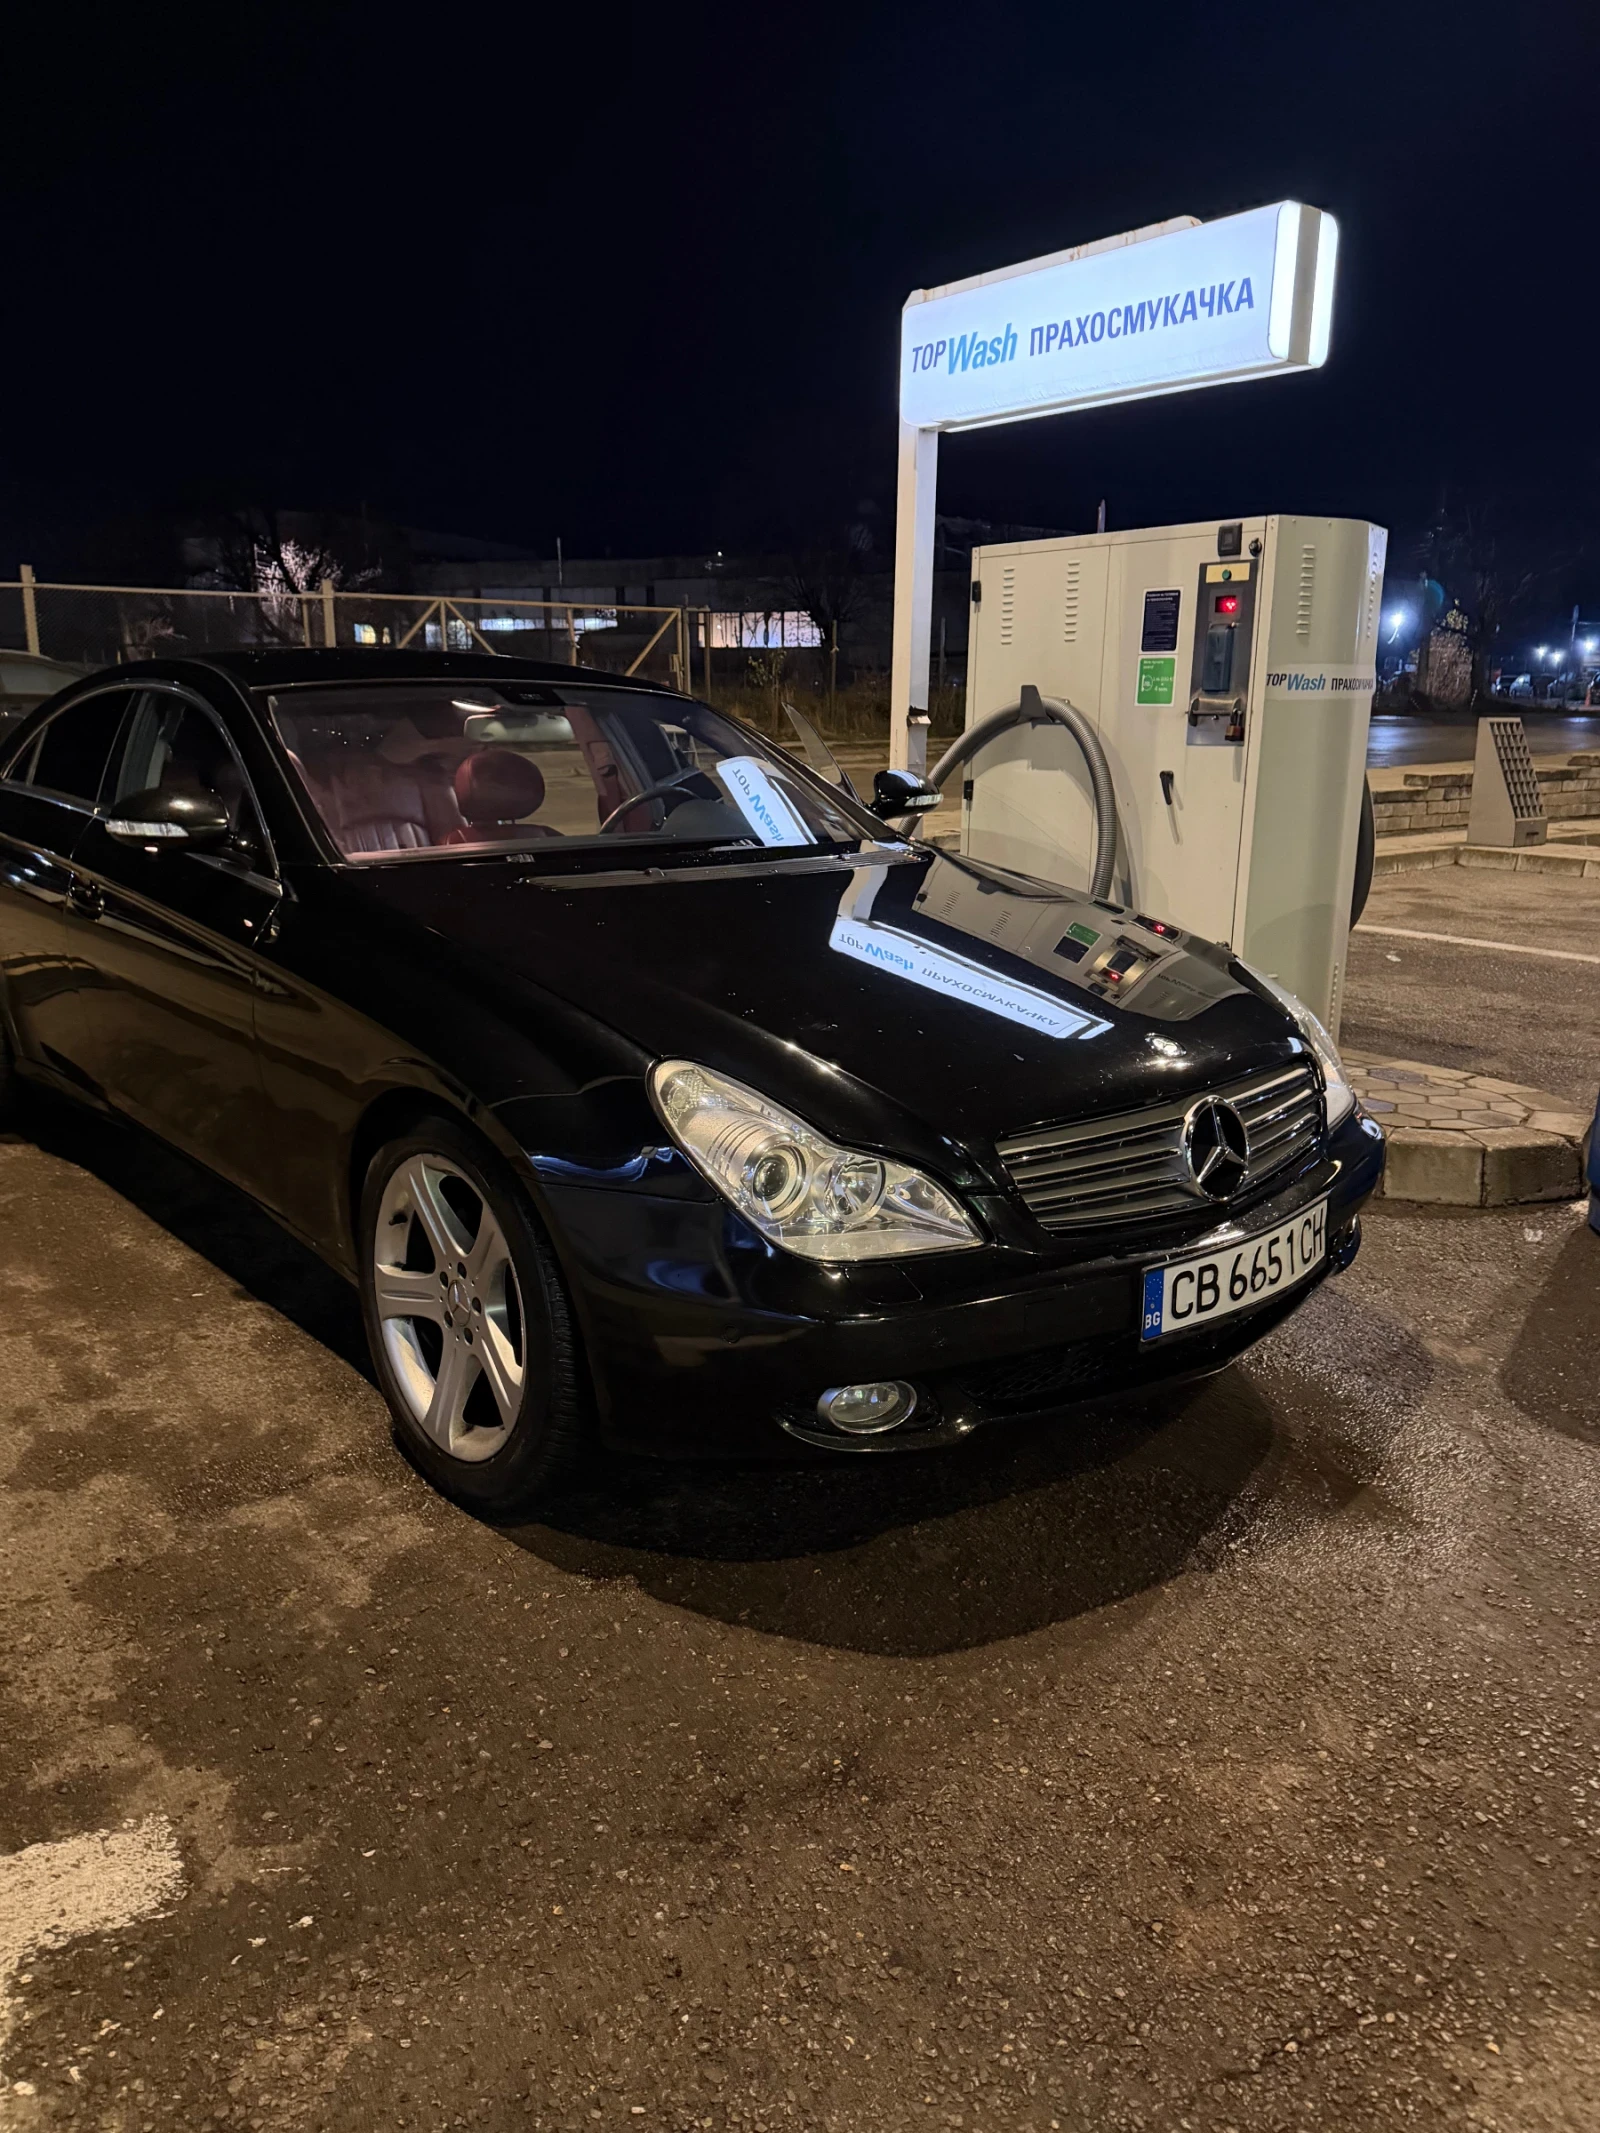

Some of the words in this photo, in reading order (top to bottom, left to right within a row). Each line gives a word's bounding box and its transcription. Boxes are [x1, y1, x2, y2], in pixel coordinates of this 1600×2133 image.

[1029, 277, 1254, 356] ПРАХОСМУКАЧКА
[1229, 1229, 1295, 1301] 6651
[1145, 1311, 1160, 1329] BG
